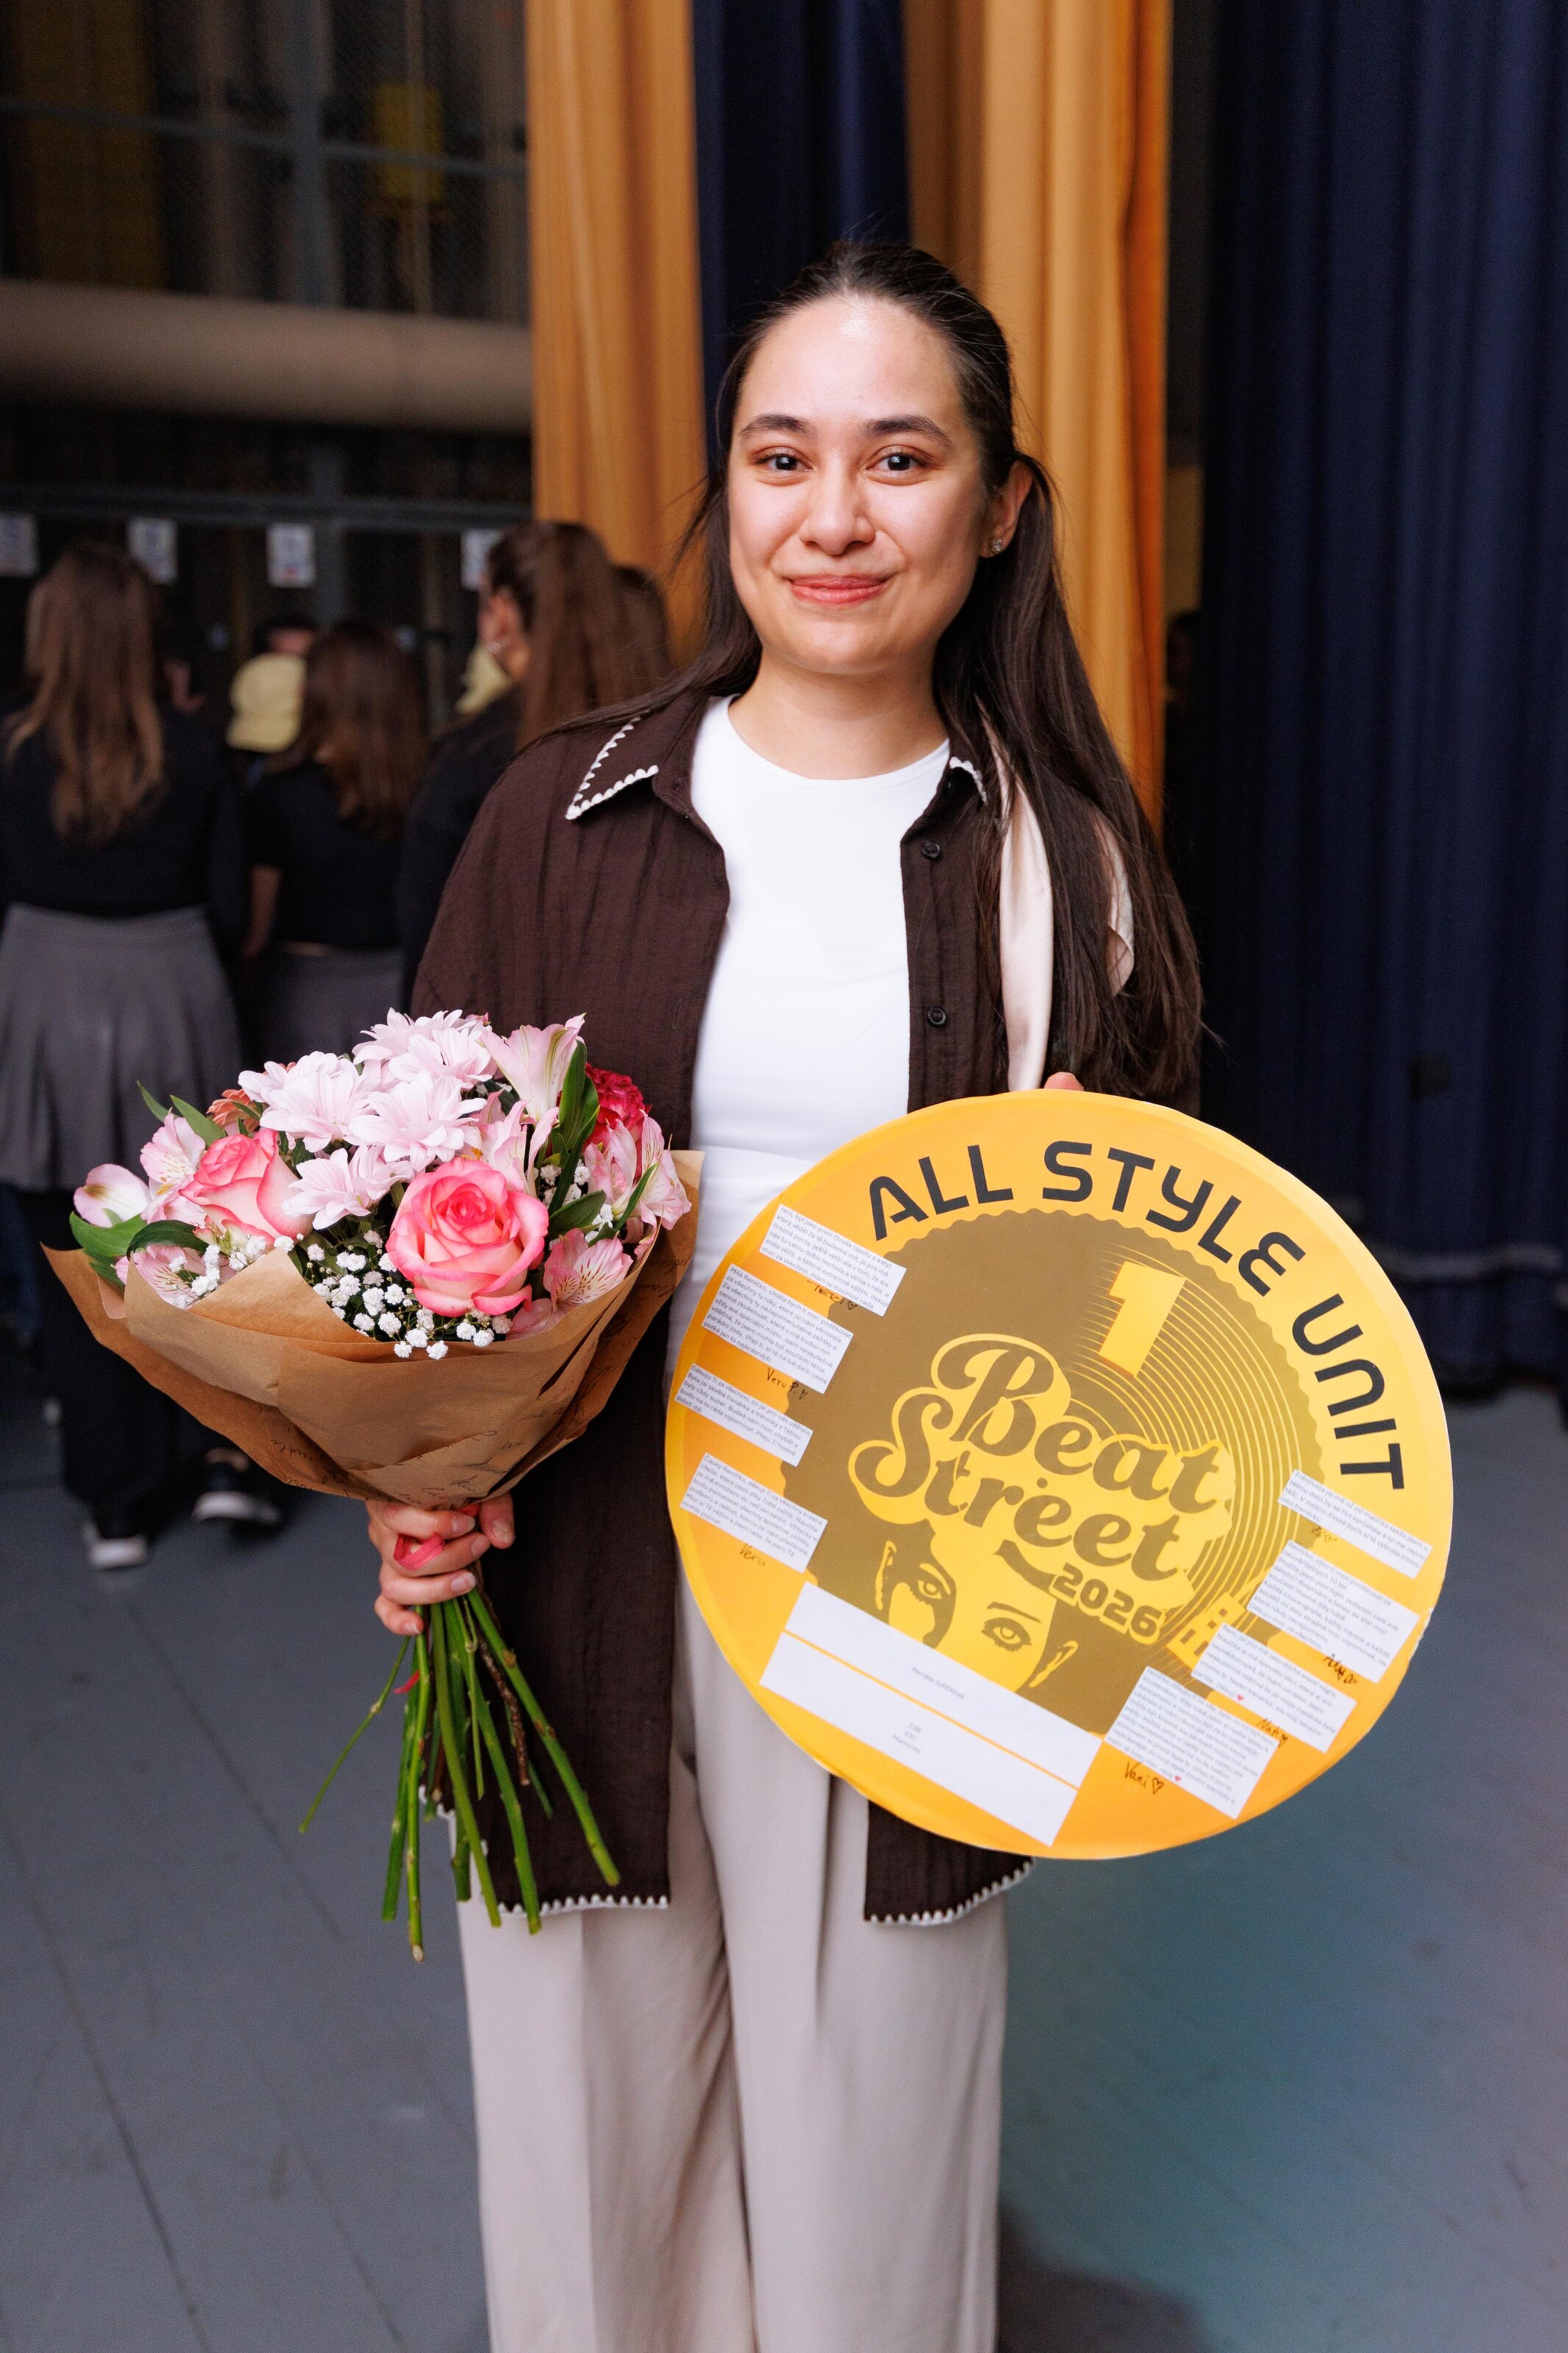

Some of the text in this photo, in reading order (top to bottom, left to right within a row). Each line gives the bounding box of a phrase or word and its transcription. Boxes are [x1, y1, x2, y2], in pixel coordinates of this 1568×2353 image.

[719, 1330, 730, 1339] jen
[740, 1322, 755, 1334] jsem
[756, 1332, 775, 1345] mohla
[787, 1299, 802, 1311] bych
[807, 1312, 820, 1321] moc
[870, 1141, 1404, 1489] ALL STYLE UNIT
[1098, 1261, 1185, 1377] 1
[784, 1337, 799, 1349] Jsem
[801, 1336, 820, 1350] budou
[938, 1340, 1220, 1514] Beat
[855, 1394, 1180, 1581] Street
[1053, 1563, 1160, 1638] 2026
